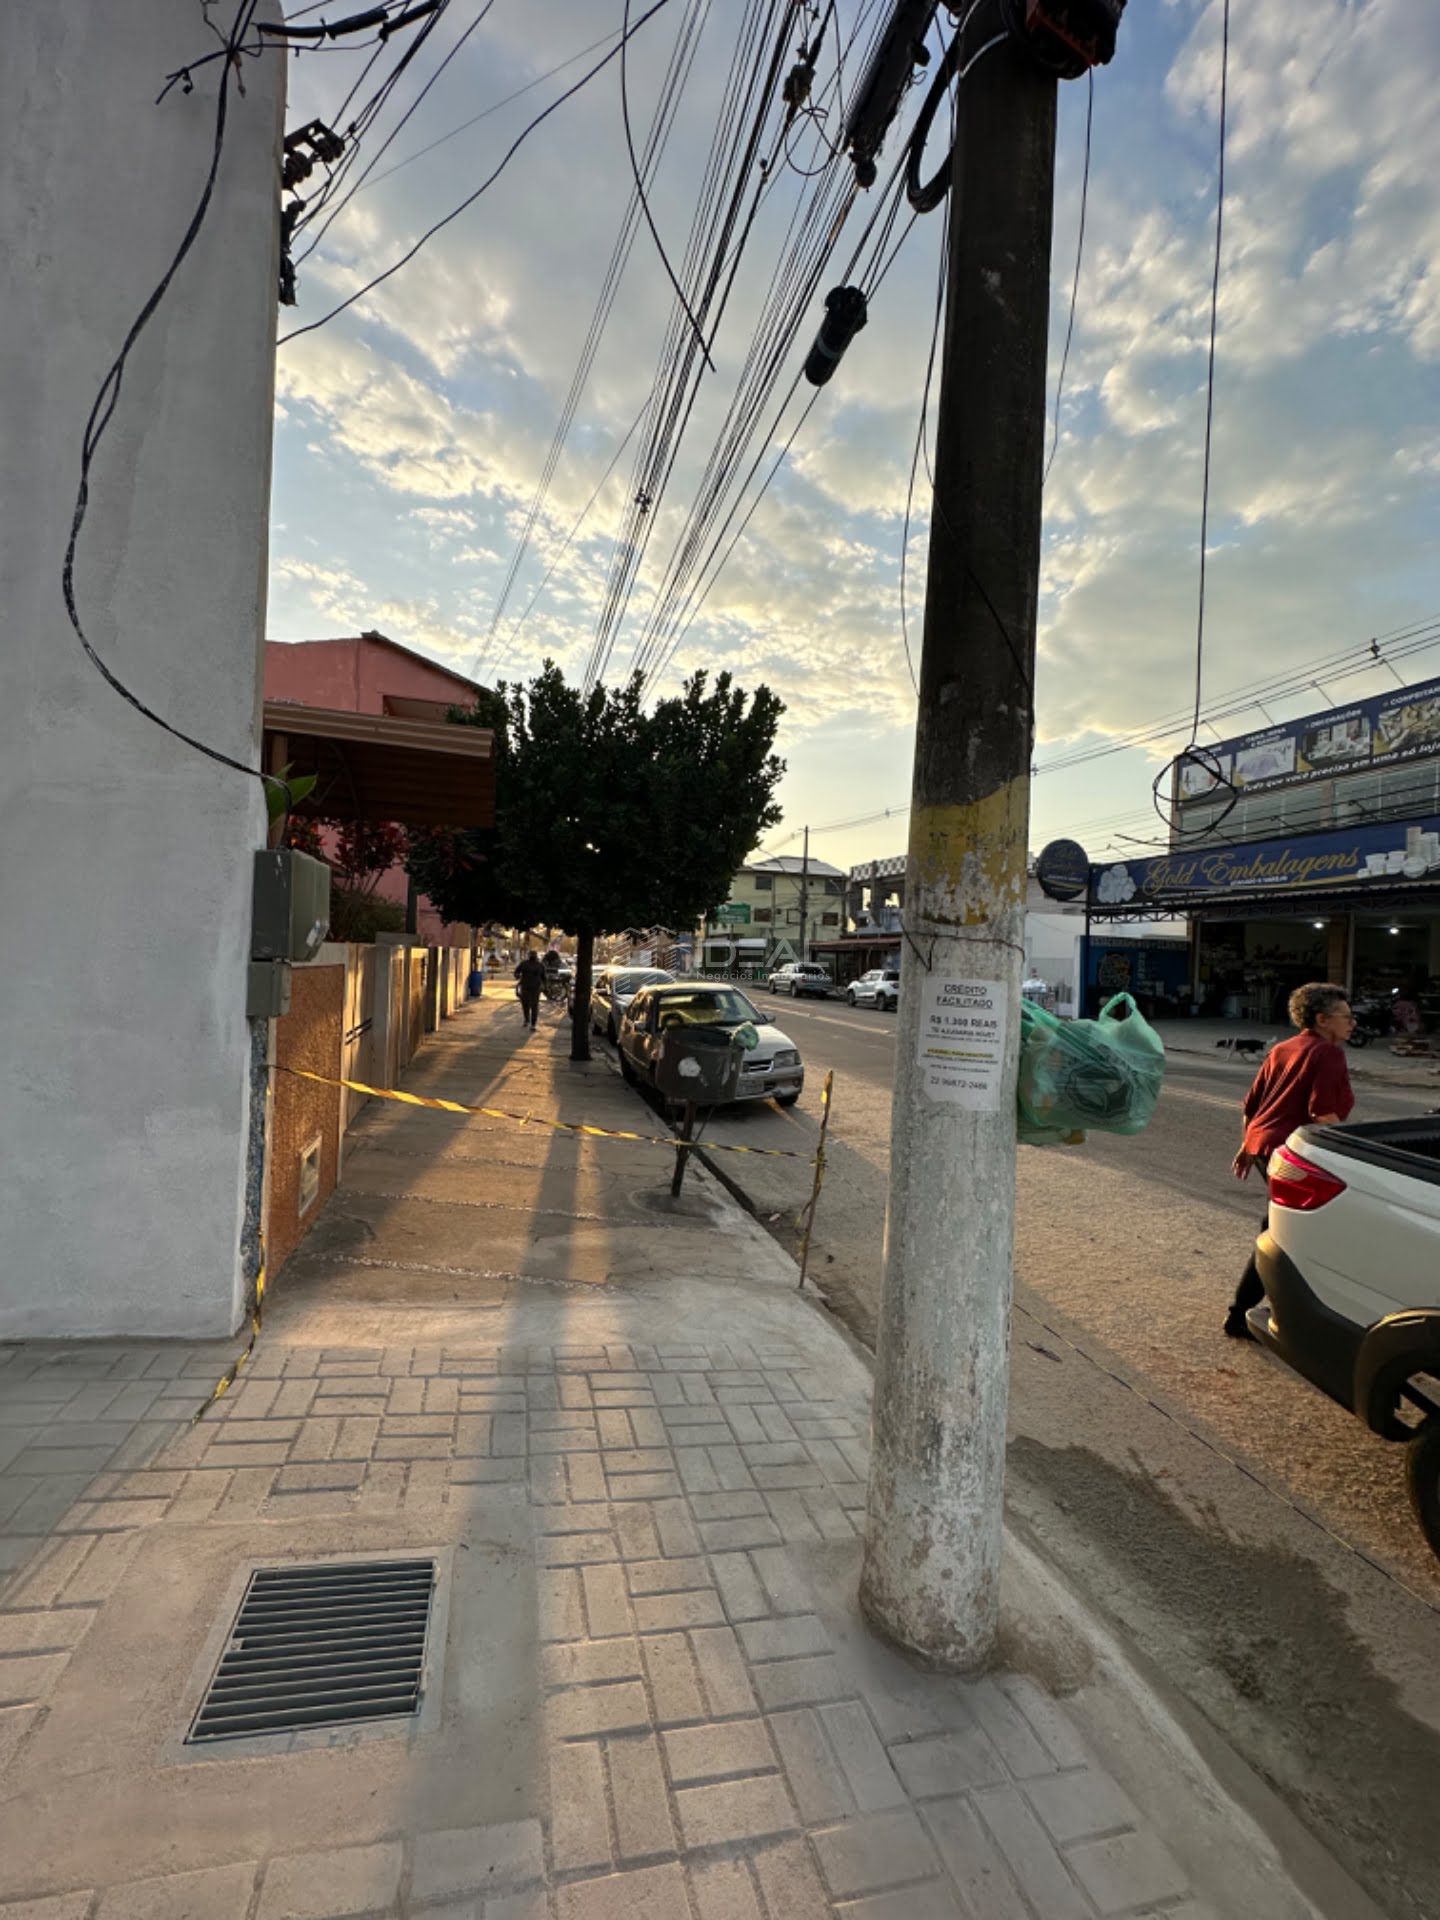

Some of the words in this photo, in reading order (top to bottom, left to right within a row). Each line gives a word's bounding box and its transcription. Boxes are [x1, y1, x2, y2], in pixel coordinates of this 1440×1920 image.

[1142, 859, 1198, 896] Gold
[1201, 847, 1359, 884] Embalagens
[971, 1019, 998, 1029] REAIS
